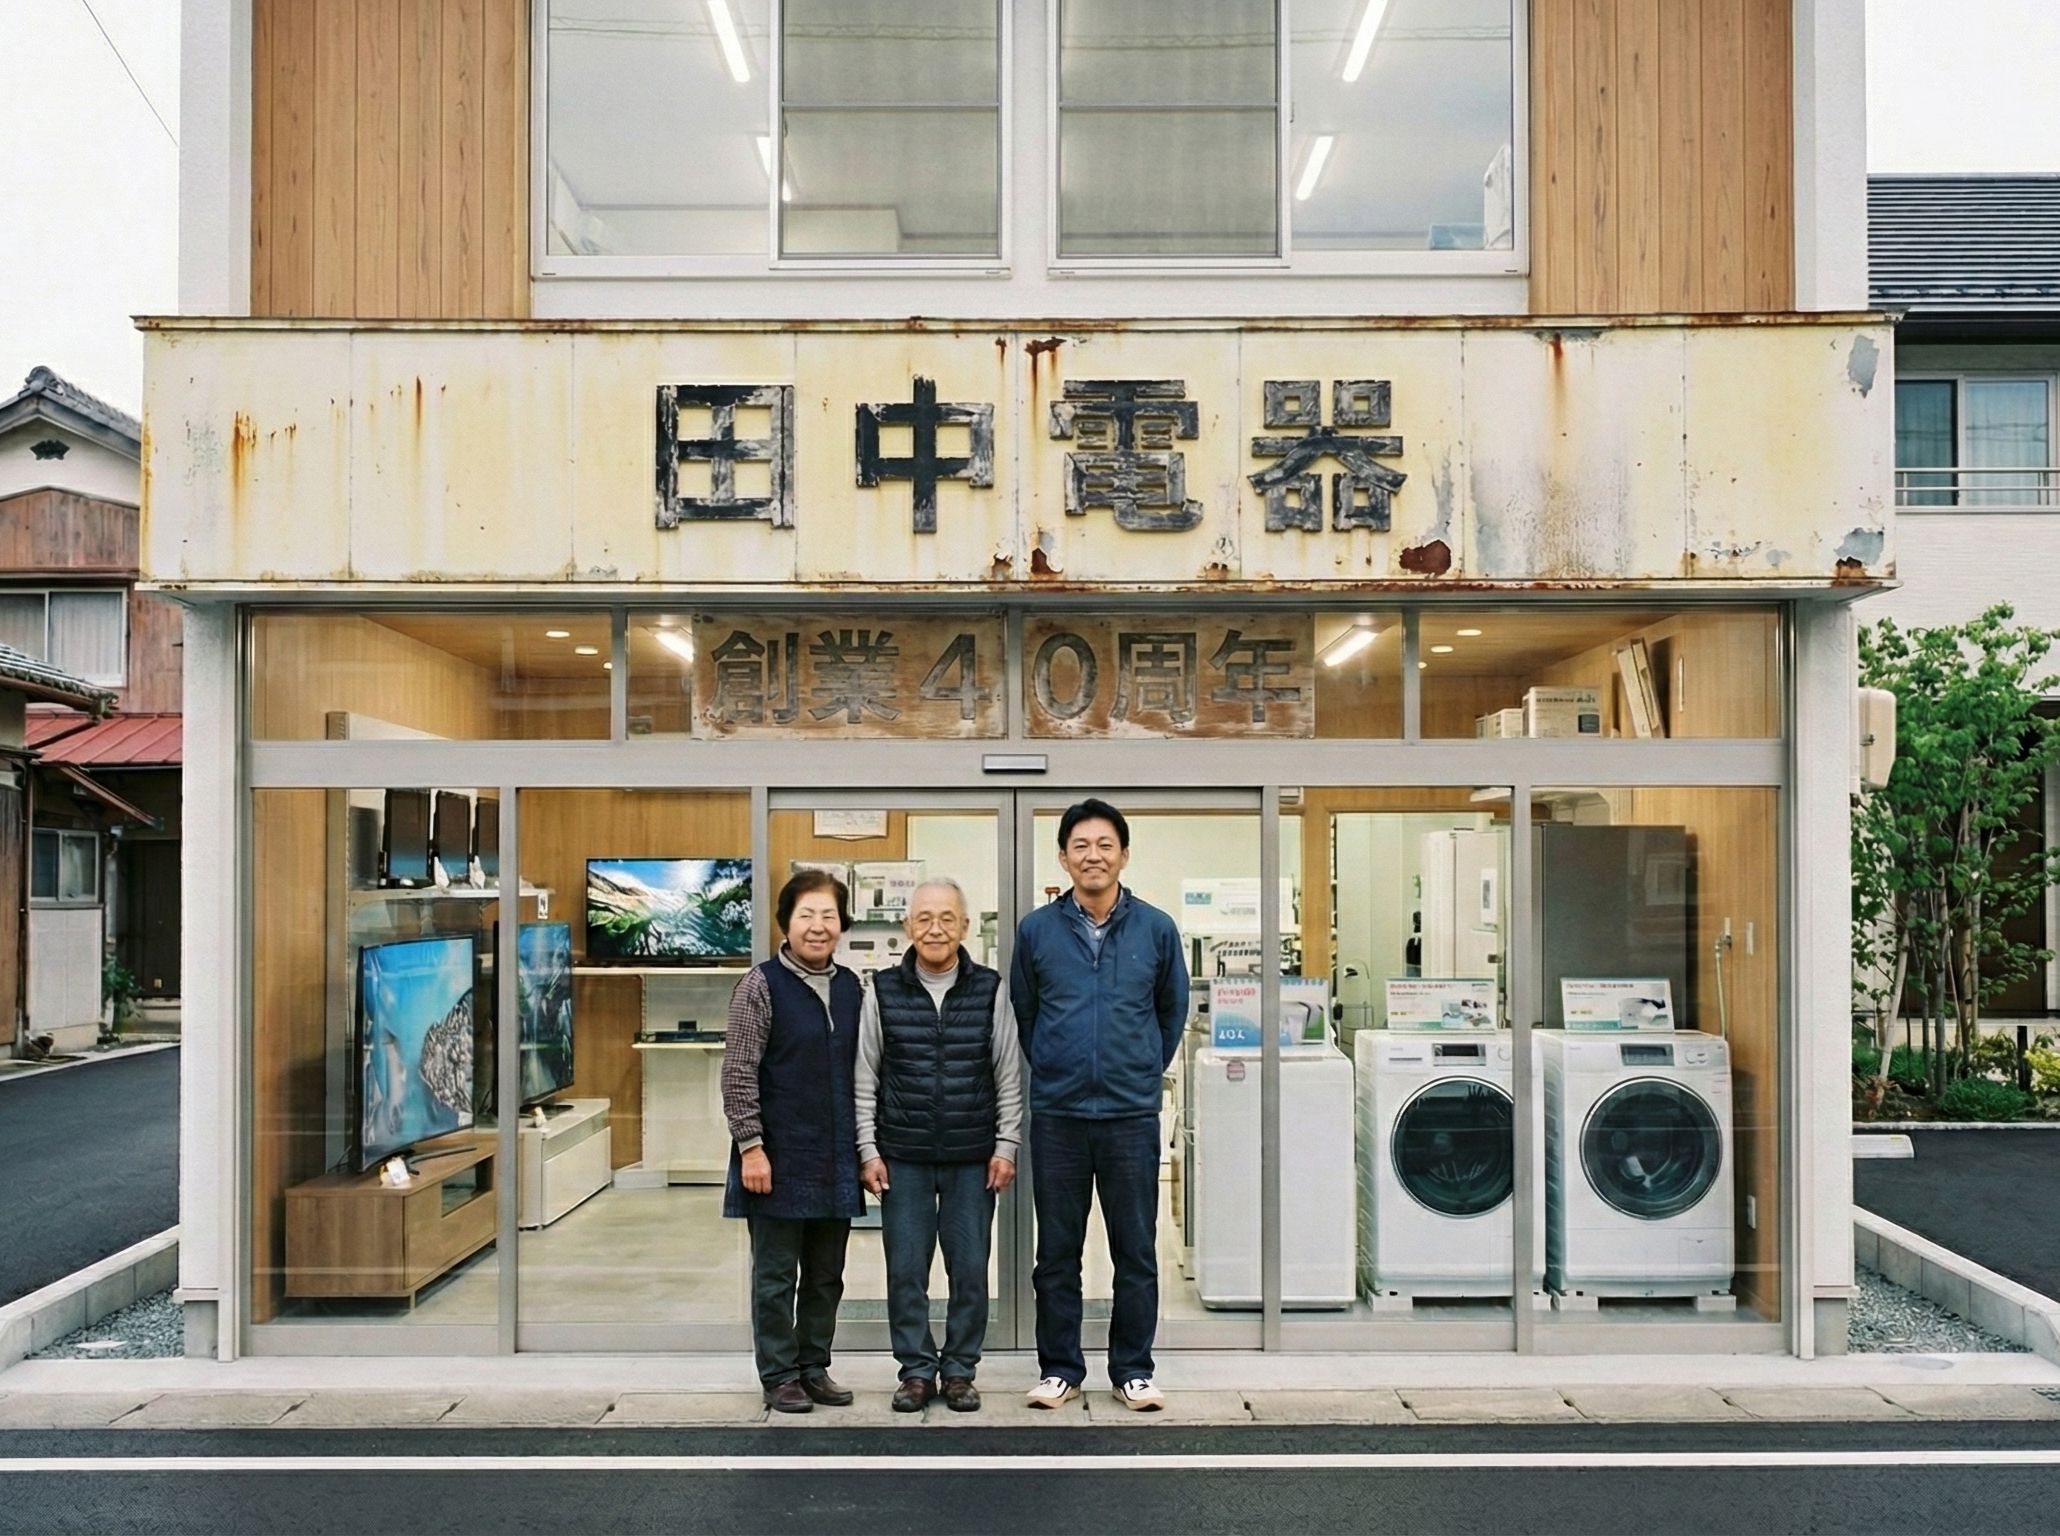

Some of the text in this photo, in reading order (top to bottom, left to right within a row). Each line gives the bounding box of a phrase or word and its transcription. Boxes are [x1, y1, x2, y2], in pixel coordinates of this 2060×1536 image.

[655, 375, 1408, 534] 田中電器
[709, 628, 1303, 726] 創業40周年
